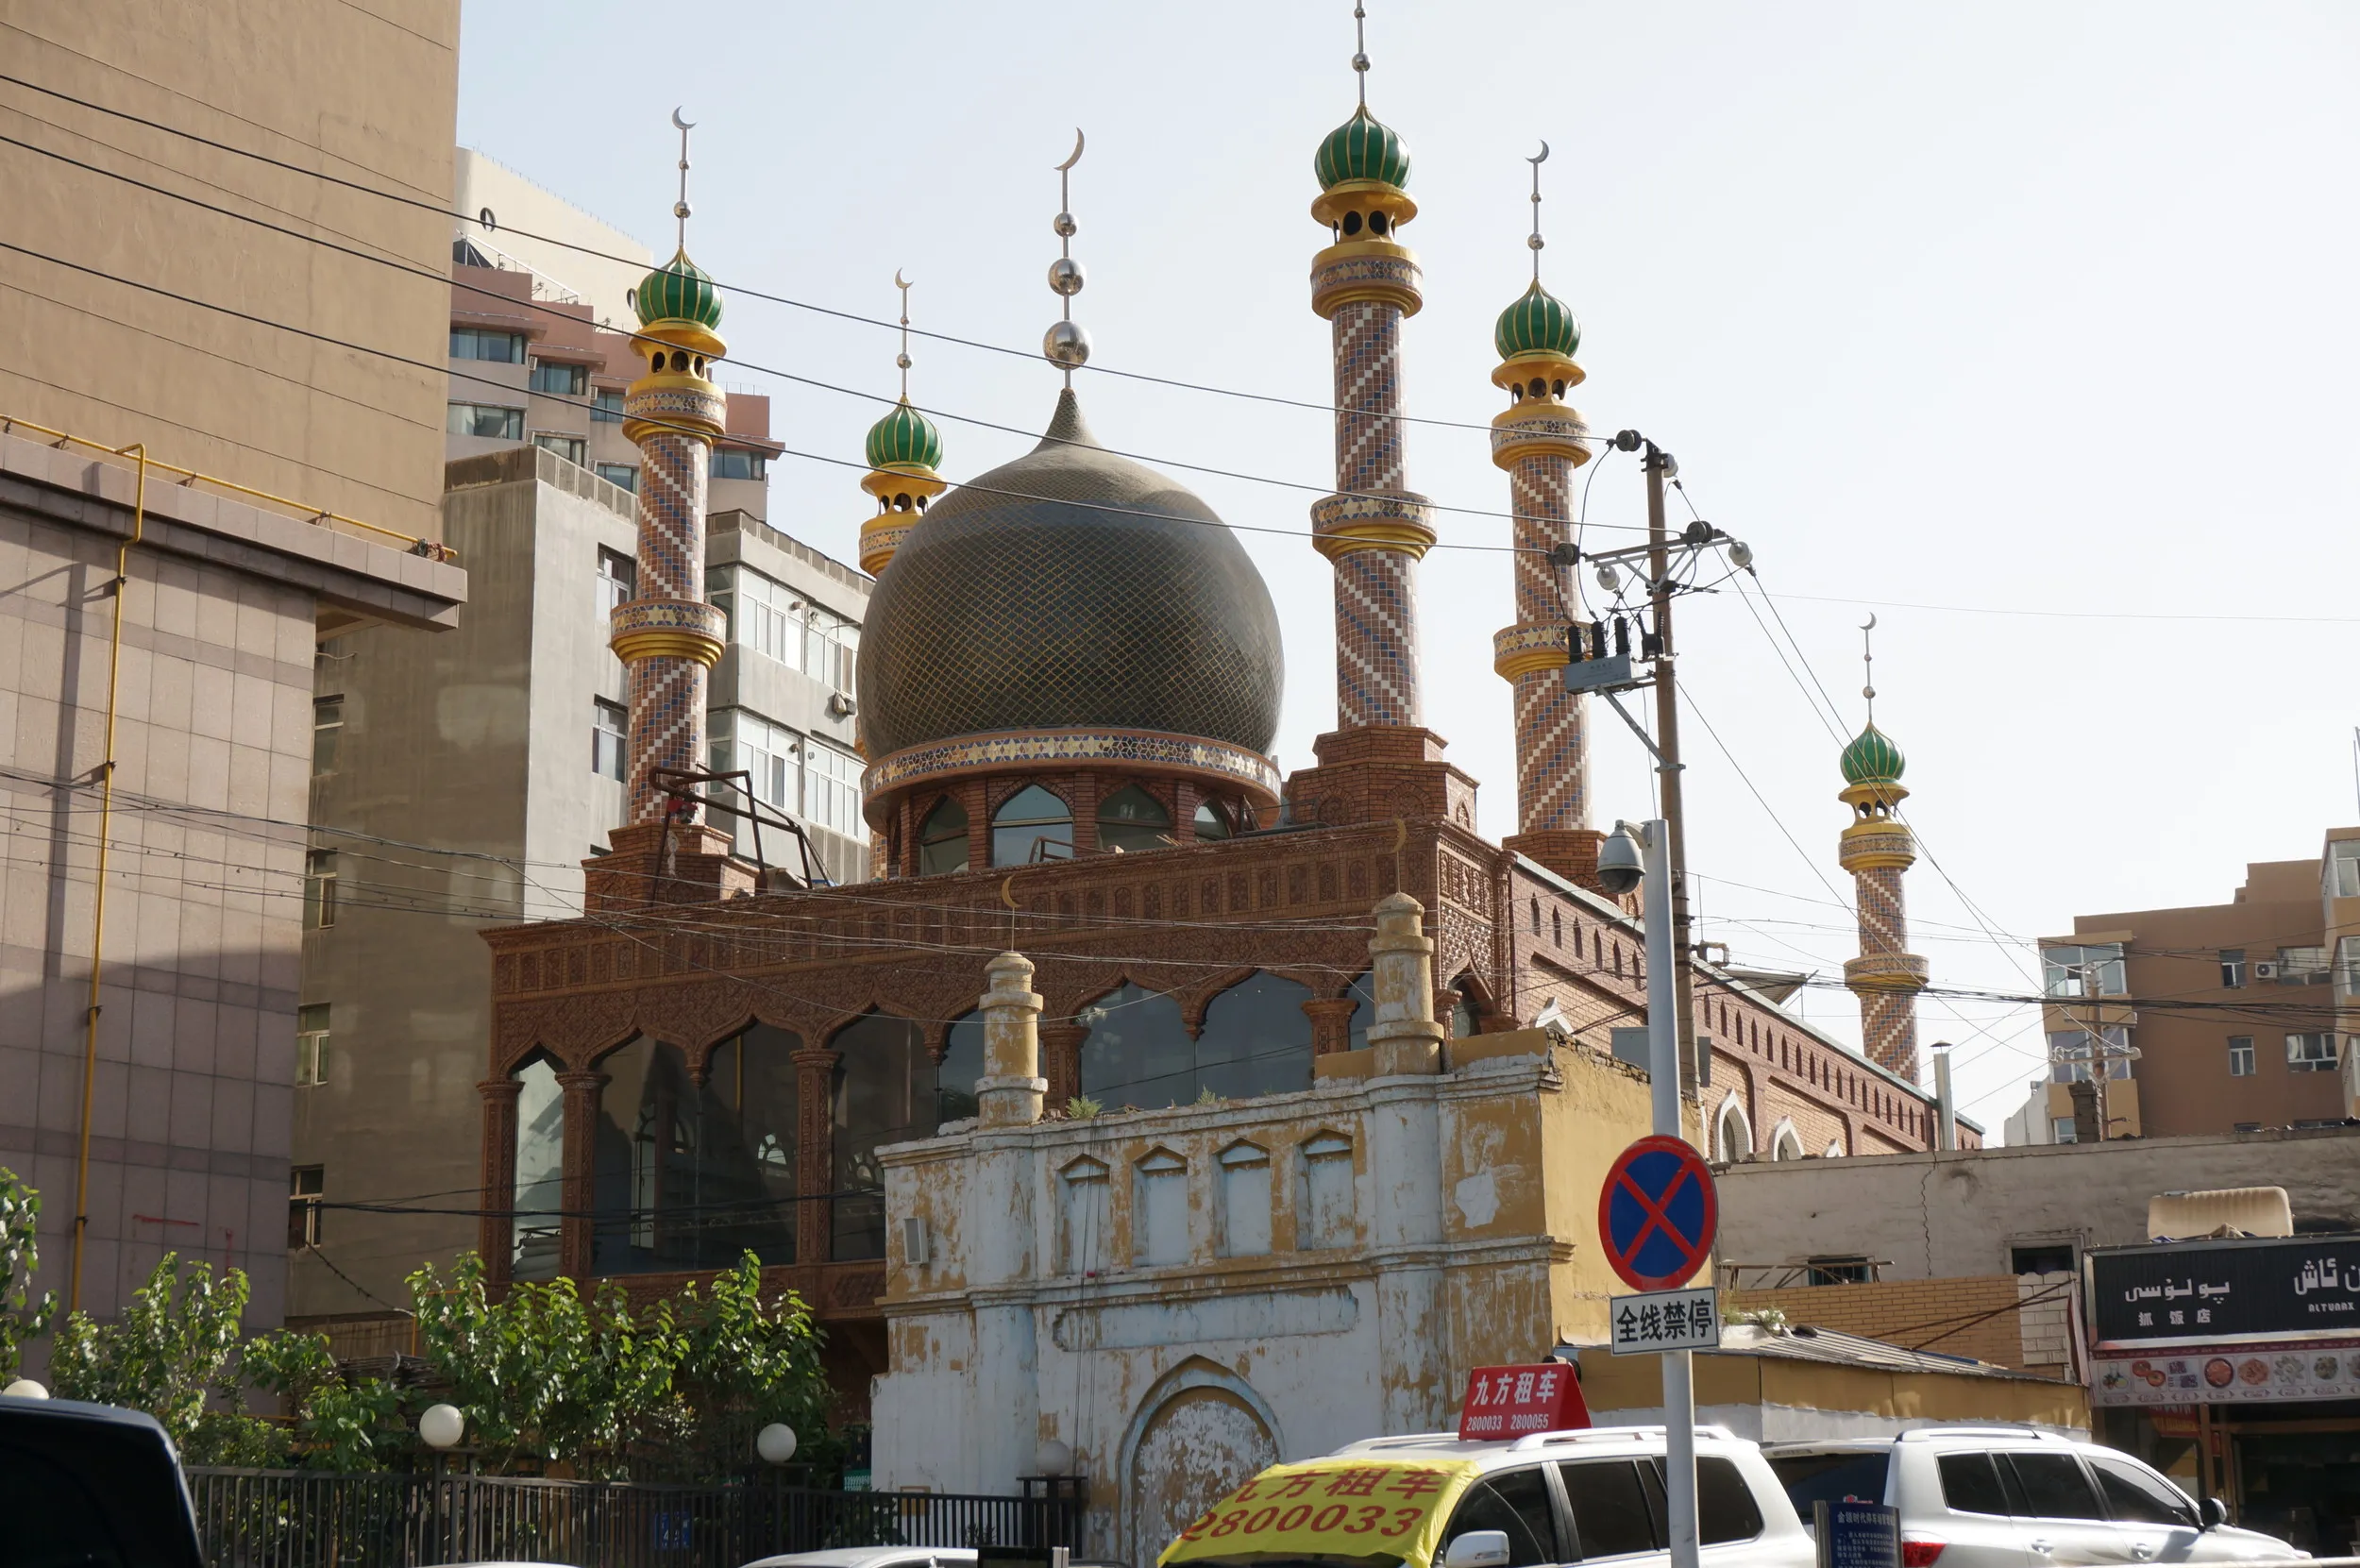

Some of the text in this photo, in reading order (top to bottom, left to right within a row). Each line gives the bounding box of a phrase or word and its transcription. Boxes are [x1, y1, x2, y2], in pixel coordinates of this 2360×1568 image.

[1616, 1298, 1712, 1343] 全线禁停
[1473, 1371, 1558, 1406] 九方租车
[1466, 1413, 1549, 1431] 2800033 2800055
[1181, 1504, 1424, 1542] 2800033
